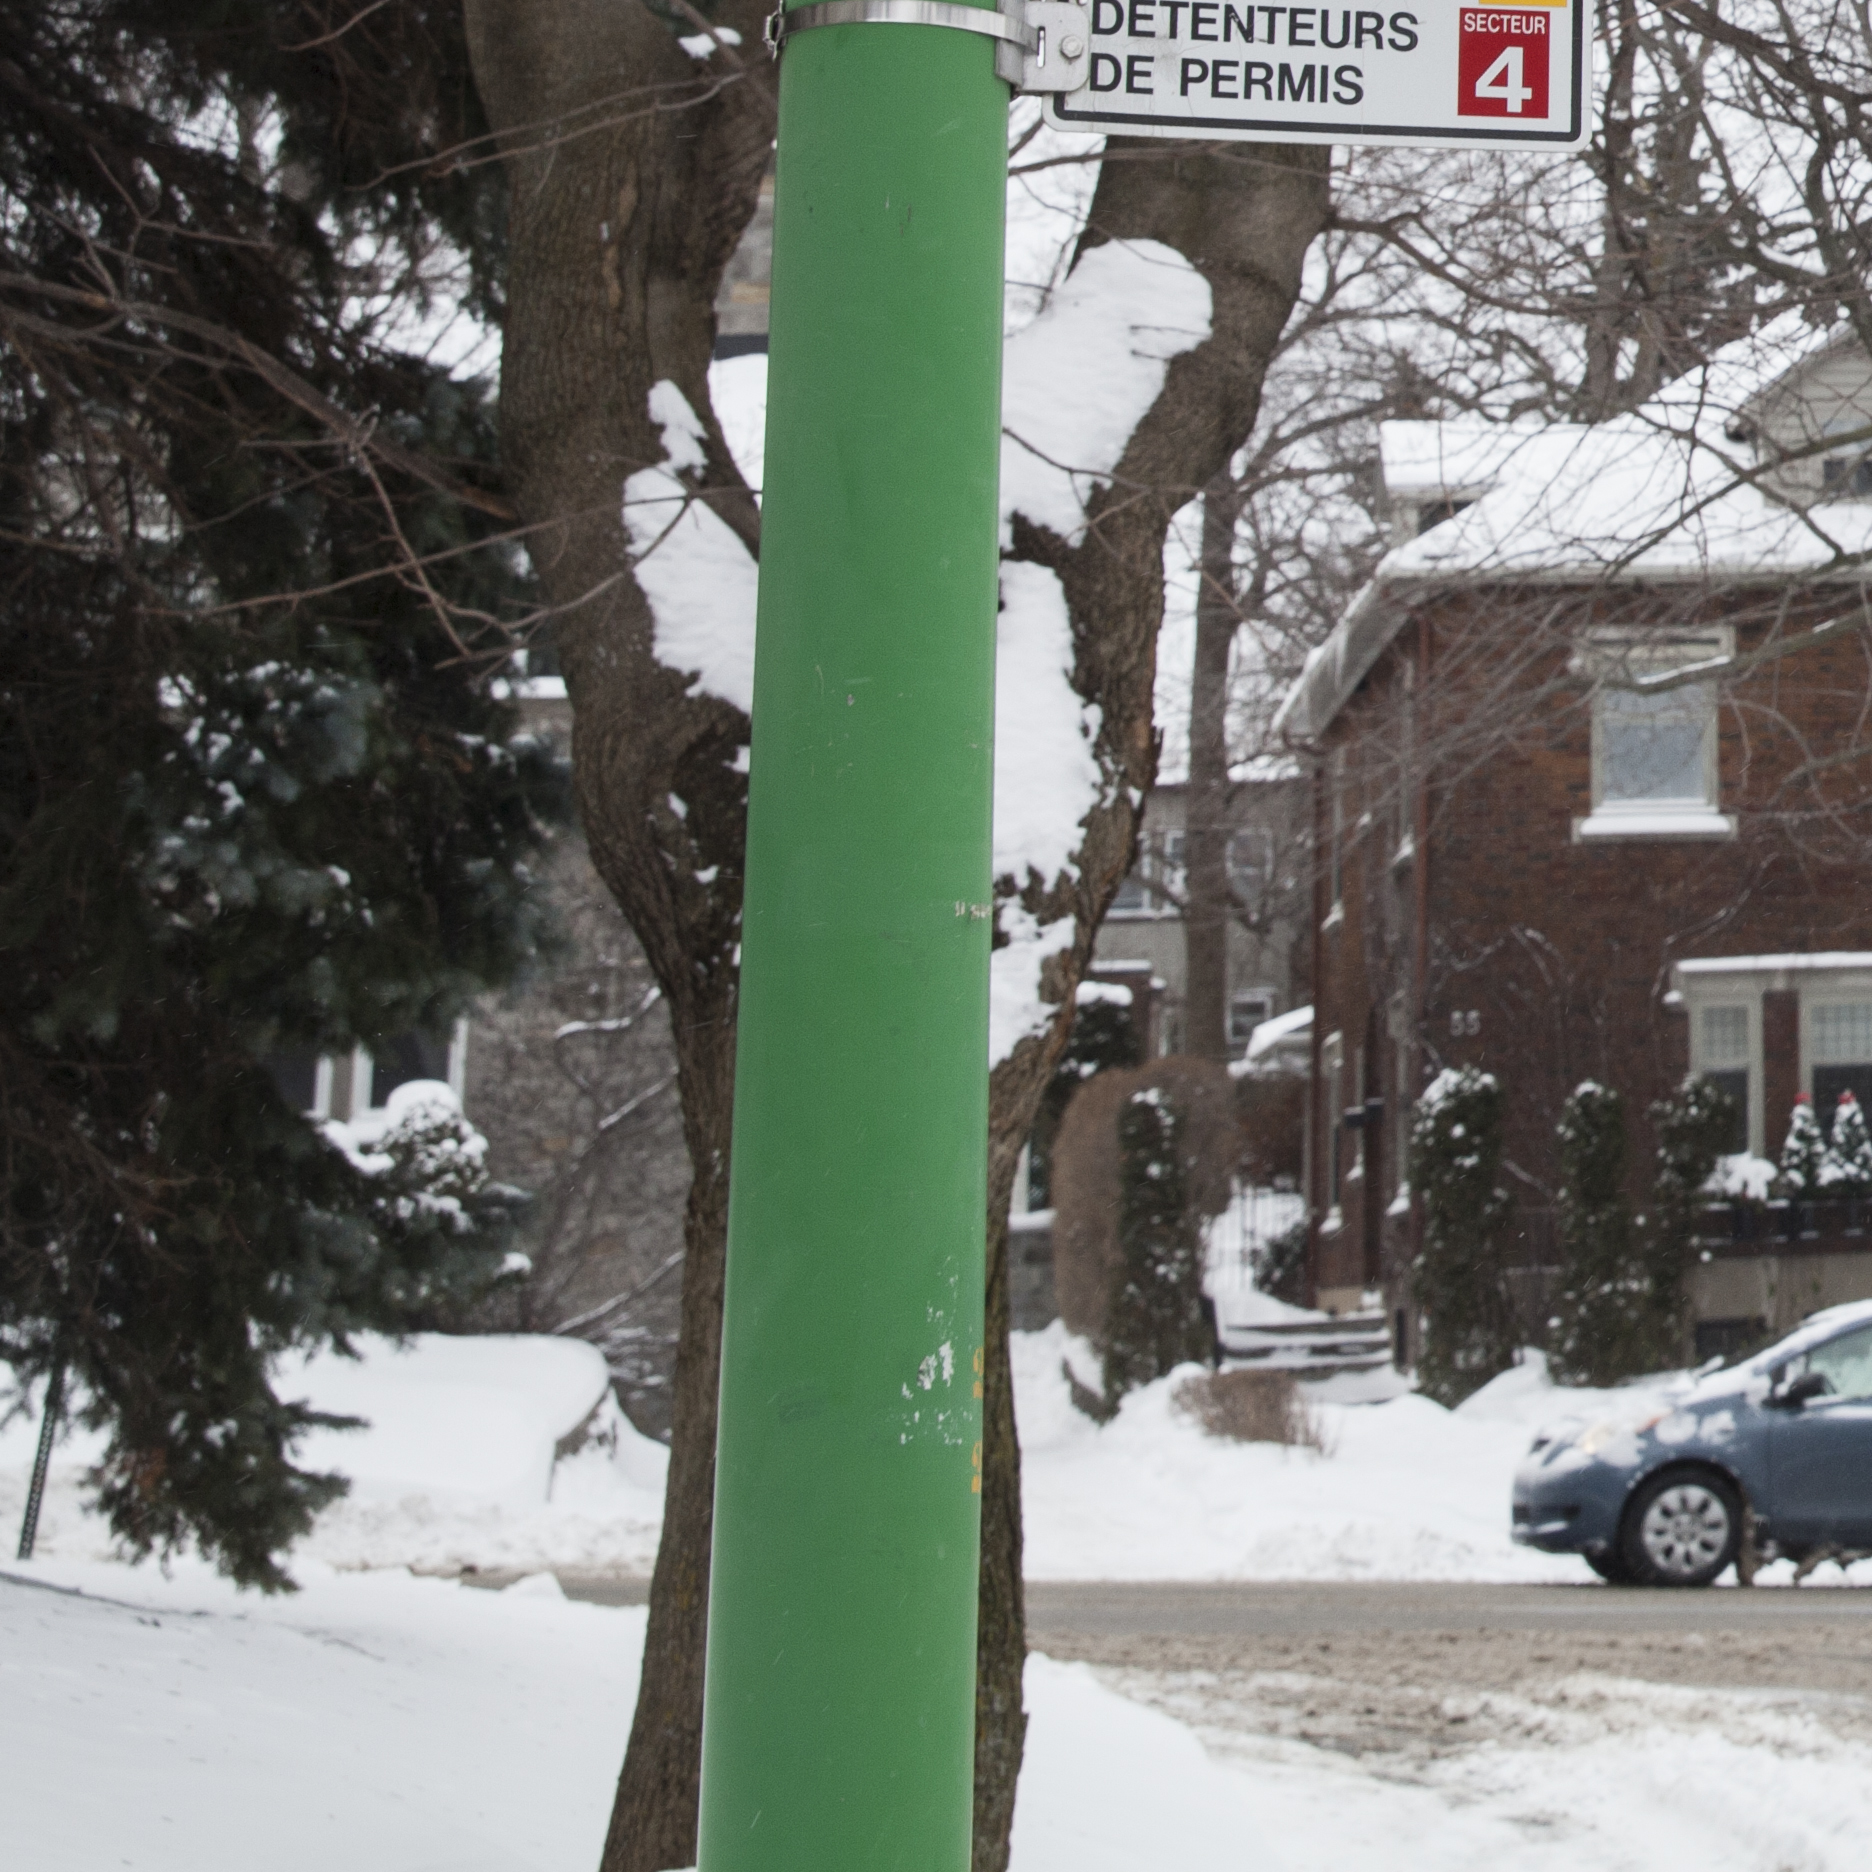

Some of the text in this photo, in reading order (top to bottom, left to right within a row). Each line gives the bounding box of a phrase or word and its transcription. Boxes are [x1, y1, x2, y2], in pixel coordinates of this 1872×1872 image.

[1463, 12, 1547, 36] SECTEUR
[1089, 52, 1365, 106] DE PERMIS
[1474, 46, 1534, 114] 4
